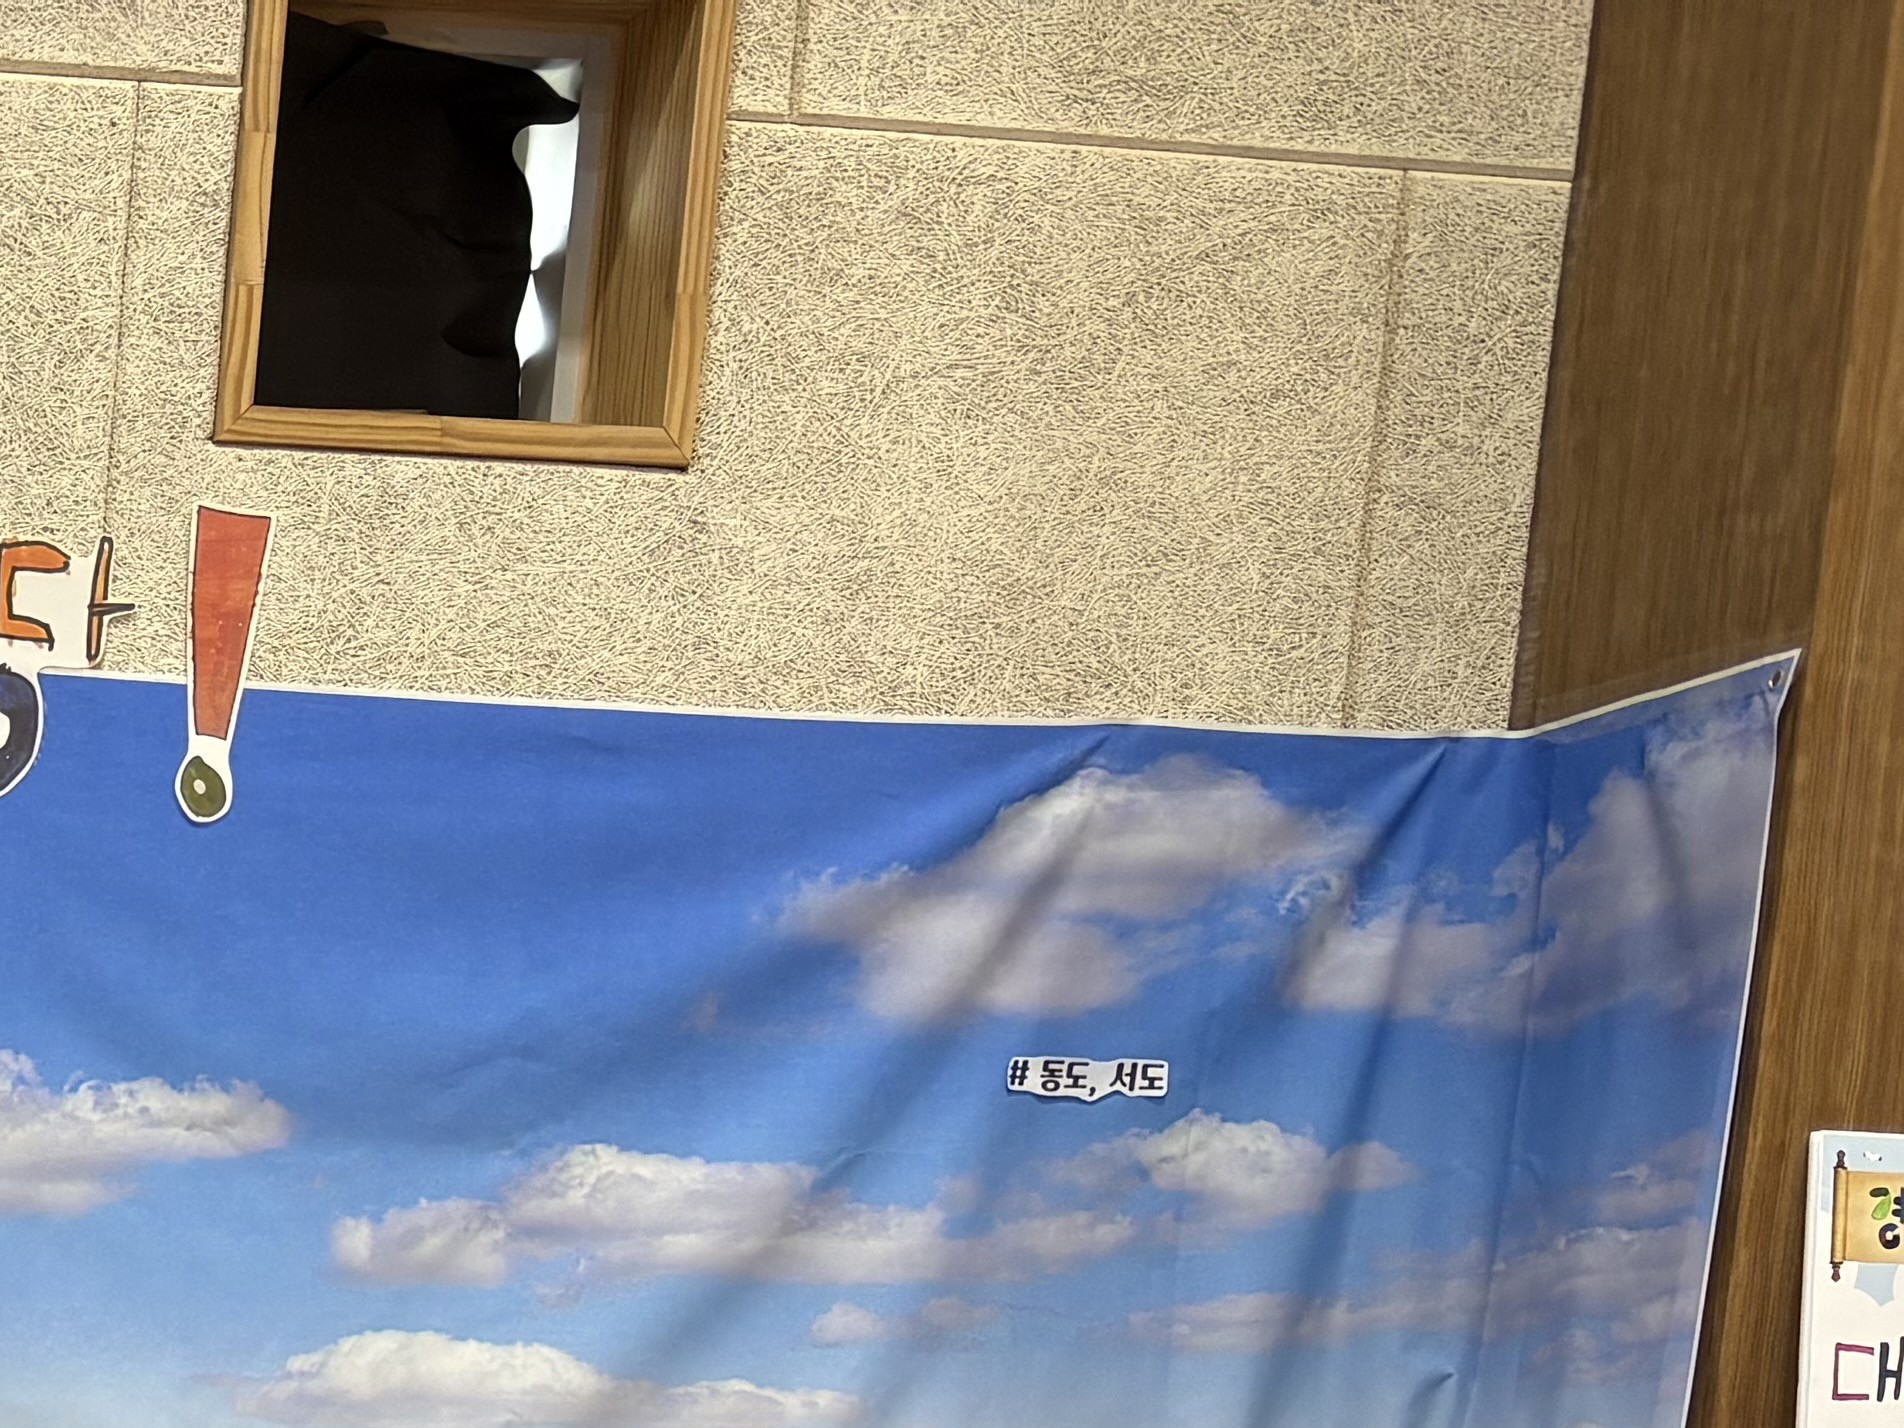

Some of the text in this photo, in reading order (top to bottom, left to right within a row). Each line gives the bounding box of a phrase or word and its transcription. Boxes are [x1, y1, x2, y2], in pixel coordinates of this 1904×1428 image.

[1009, 1059, 1165, 1097] # 동도, 서도
